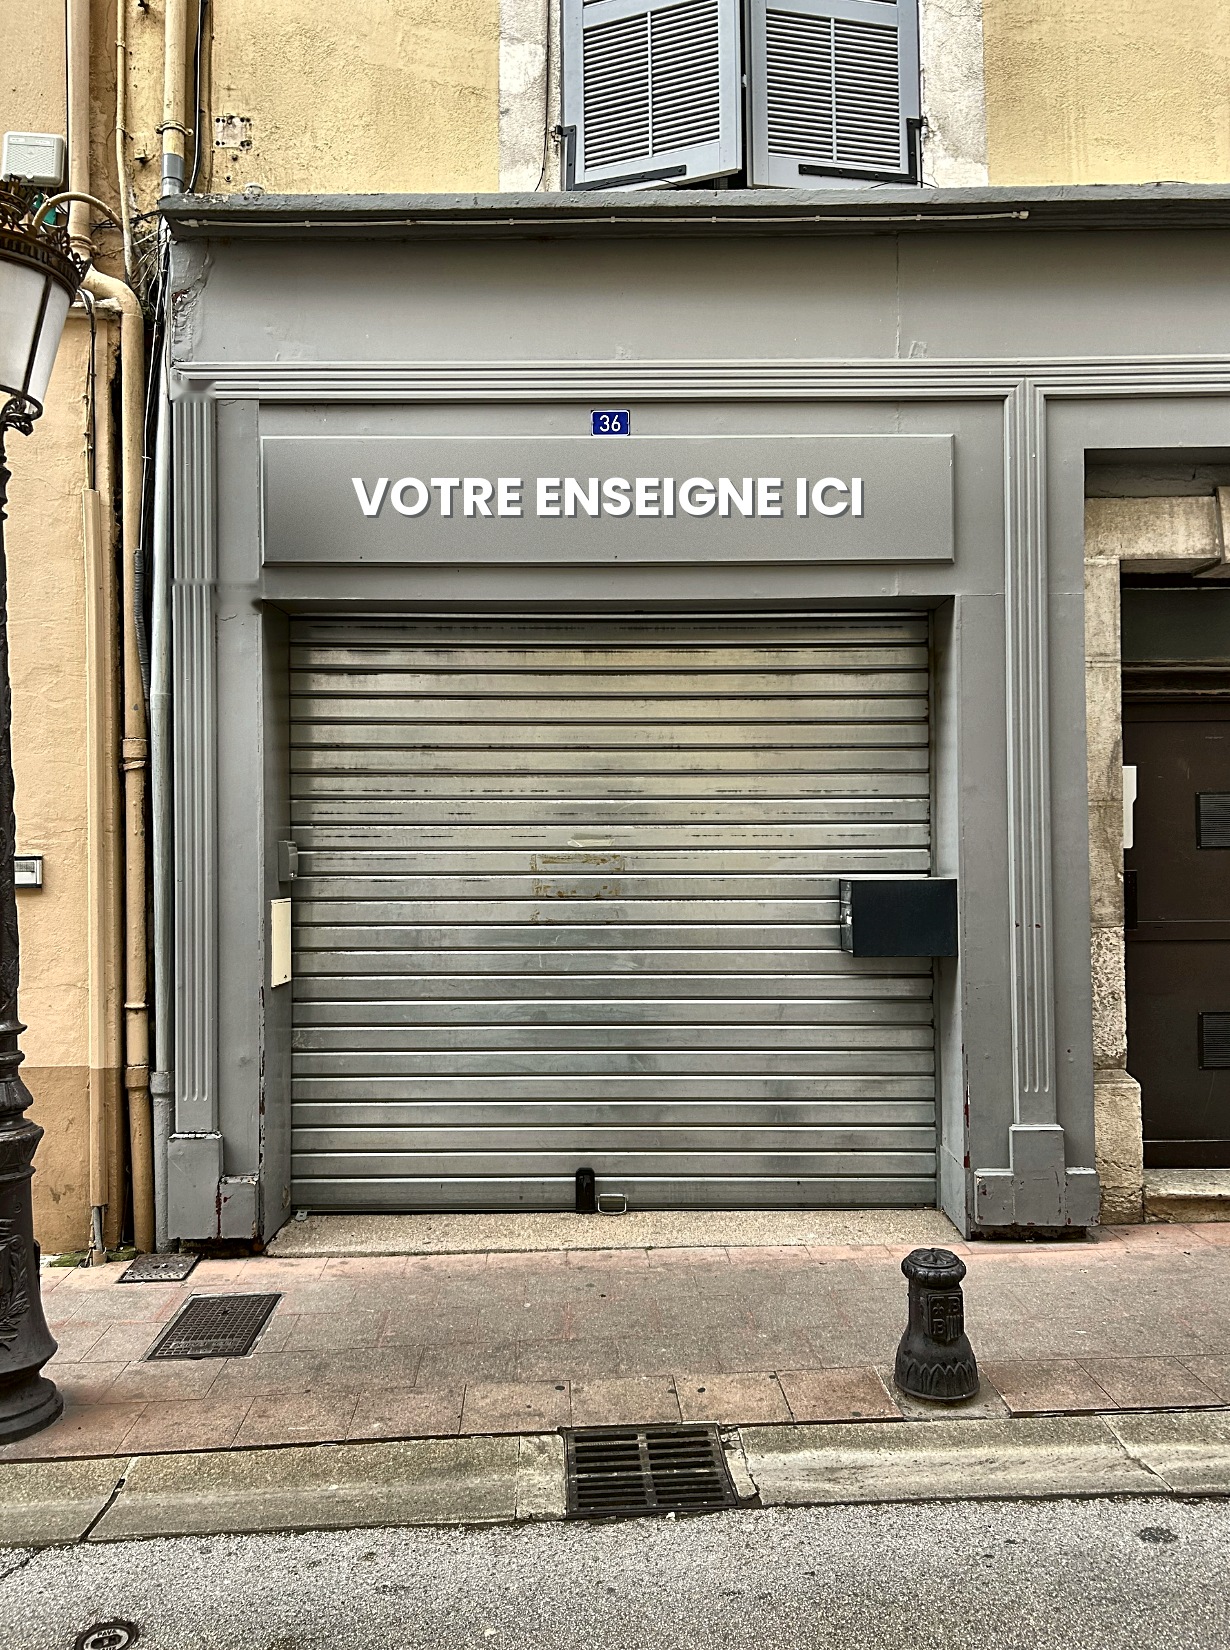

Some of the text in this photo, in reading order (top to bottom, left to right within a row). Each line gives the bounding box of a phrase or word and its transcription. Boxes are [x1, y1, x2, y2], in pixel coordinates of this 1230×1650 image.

[599, 414, 621, 432] 36
[351, 477, 863, 517] VOTRE ENSEIGNE ICI
